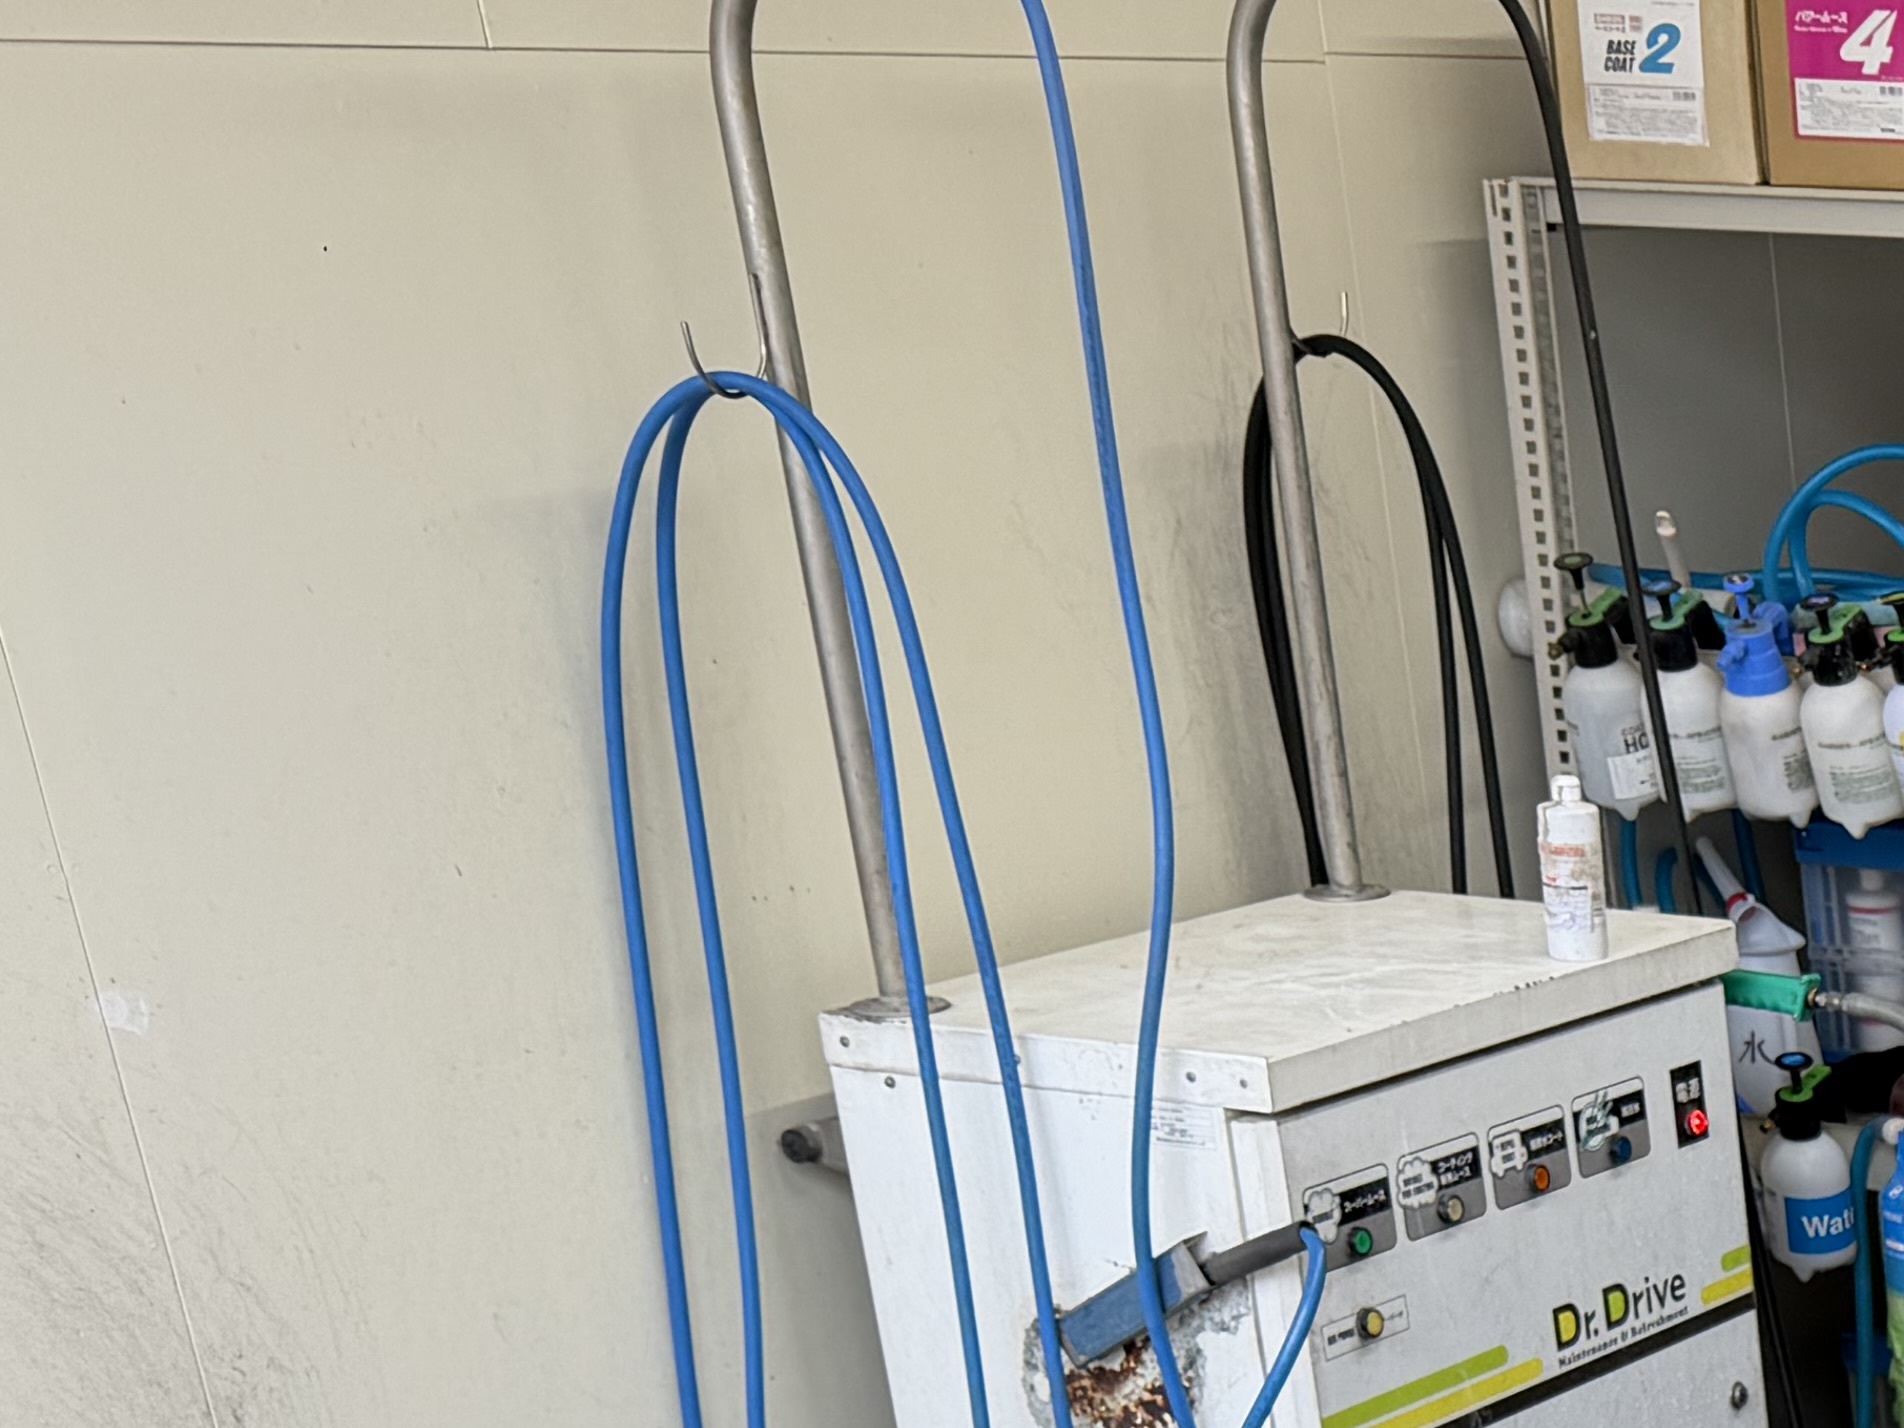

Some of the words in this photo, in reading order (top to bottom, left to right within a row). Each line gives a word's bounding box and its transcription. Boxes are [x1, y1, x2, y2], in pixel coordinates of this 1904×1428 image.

[1606, 39, 1636, 55] BASE
[1638, 22, 1681, 74] 2
[1839, 9, 1898, 76] 4
[1604, 56, 1635, 73] COAT
[1738, 1030, 1777, 1065] 水
[1801, 1206, 1855, 1239] Wat
[1552, 1302, 1599, 1352] Dr.
[1602, 1273, 1687, 1331] Drive
